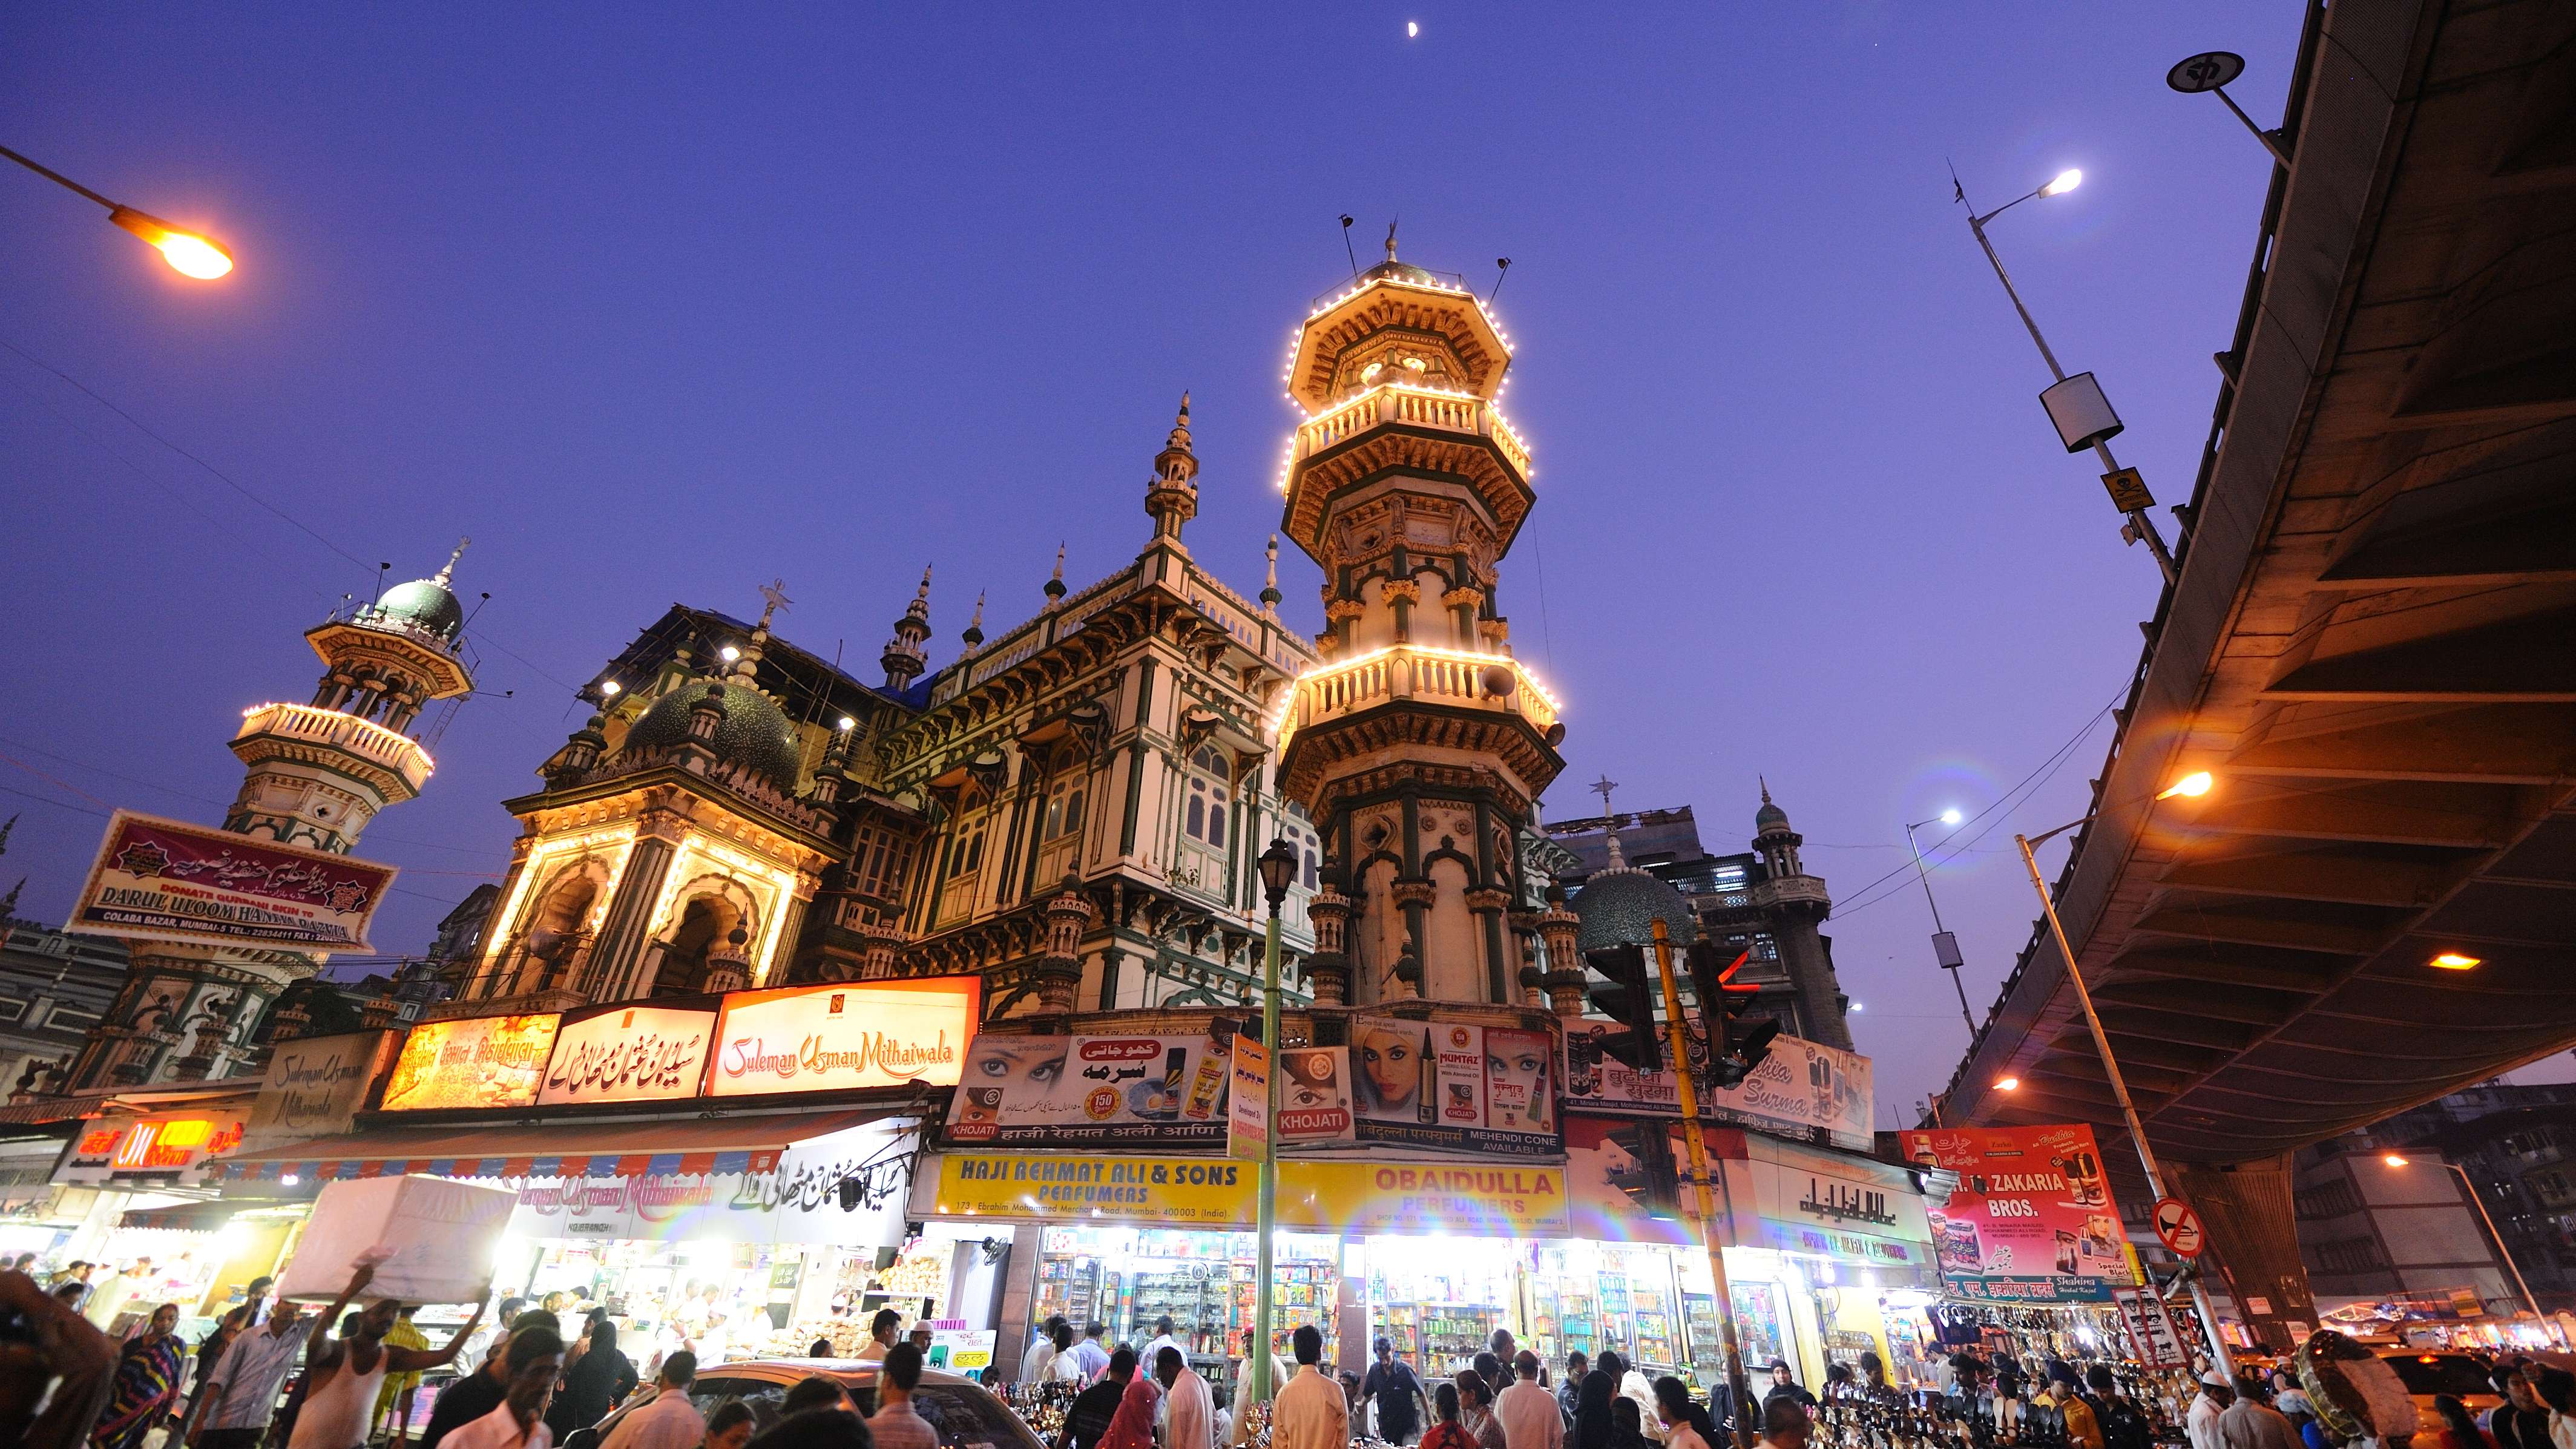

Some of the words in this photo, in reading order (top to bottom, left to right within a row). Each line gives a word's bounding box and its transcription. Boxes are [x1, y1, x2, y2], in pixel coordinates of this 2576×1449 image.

[98, 887, 168, 912] DARUL
[169, 896, 235, 921] ULOOM
[160, 884, 214, 899] DONATE
[272, 904, 299, 915] SKIN
[103, 912, 142, 924] COLABA
[144, 915, 177, 927] BAZAR,
[293, 932, 310, 941] FAX
[1355, 1014, 1373, 1027] Eyes
[1790, 1040, 1807, 1050] healthy
[724, 1036, 800, 1079] Suleman
[800, 1031, 859, 1074] Usman
[855, 1029, 954, 1080] Mithaiwala
[1440, 1053, 1479, 1065] MUMTAZ
[275, 1054, 324, 1088] Suleman
[323, 1054, 363, 1085] Usman
[1095, 1094, 1112, 1106] 150
[1743, 1078, 1807, 1116] Surma
[273, 1088, 331, 1129] Mithaiwala
[1238, 1104, 1256, 1118] Developed
[953, 1125, 995, 1135] KHOJATI
[1281, 1114, 1343, 1129] KHOJATI
[1000, 1126, 1047, 1141] हाजी
[1051, 1125, 1106, 1140] रेहमत
[1111, 1124, 1158, 1137] अली
[1165, 1123, 1217, 1137] आणि
[1470, 1131, 1522, 1143] MEHENDI
[1525, 1135, 1557, 1147] CONE
[2039, 1130, 2075, 1146] Budhia
[1483, 1142, 1545, 1156] AVAILABLE
[961, 1160, 1009, 1181] HAJI
[1013, 1162, 1105, 1183] REHMAT
[1110, 1164, 1146, 1184] ALI
[1150, 1165, 1169, 1185] &
[1174, 1165, 1238, 1186] SONS
[1375, 1168, 1556, 1196] OBAIDULLA
[1991, 1173, 2068, 1192] ZAKARIA
[561, 1175, 620, 1216] Usman
[615, 1175, 714, 1223] Mithaiwala
[1038, 1184, 1148, 1204] PERFUMERS
[978, 1202, 1008, 1211] Ebrahim
[1012, 1203, 1057, 1213] Mohammed
[1402, 1196, 1525, 1213] PERFUMERS
[1986, 1198, 2039, 1218] BROS.
[2098, 1262, 2126, 1271] Special
[2057, 1277, 2095, 1286] Shahina
